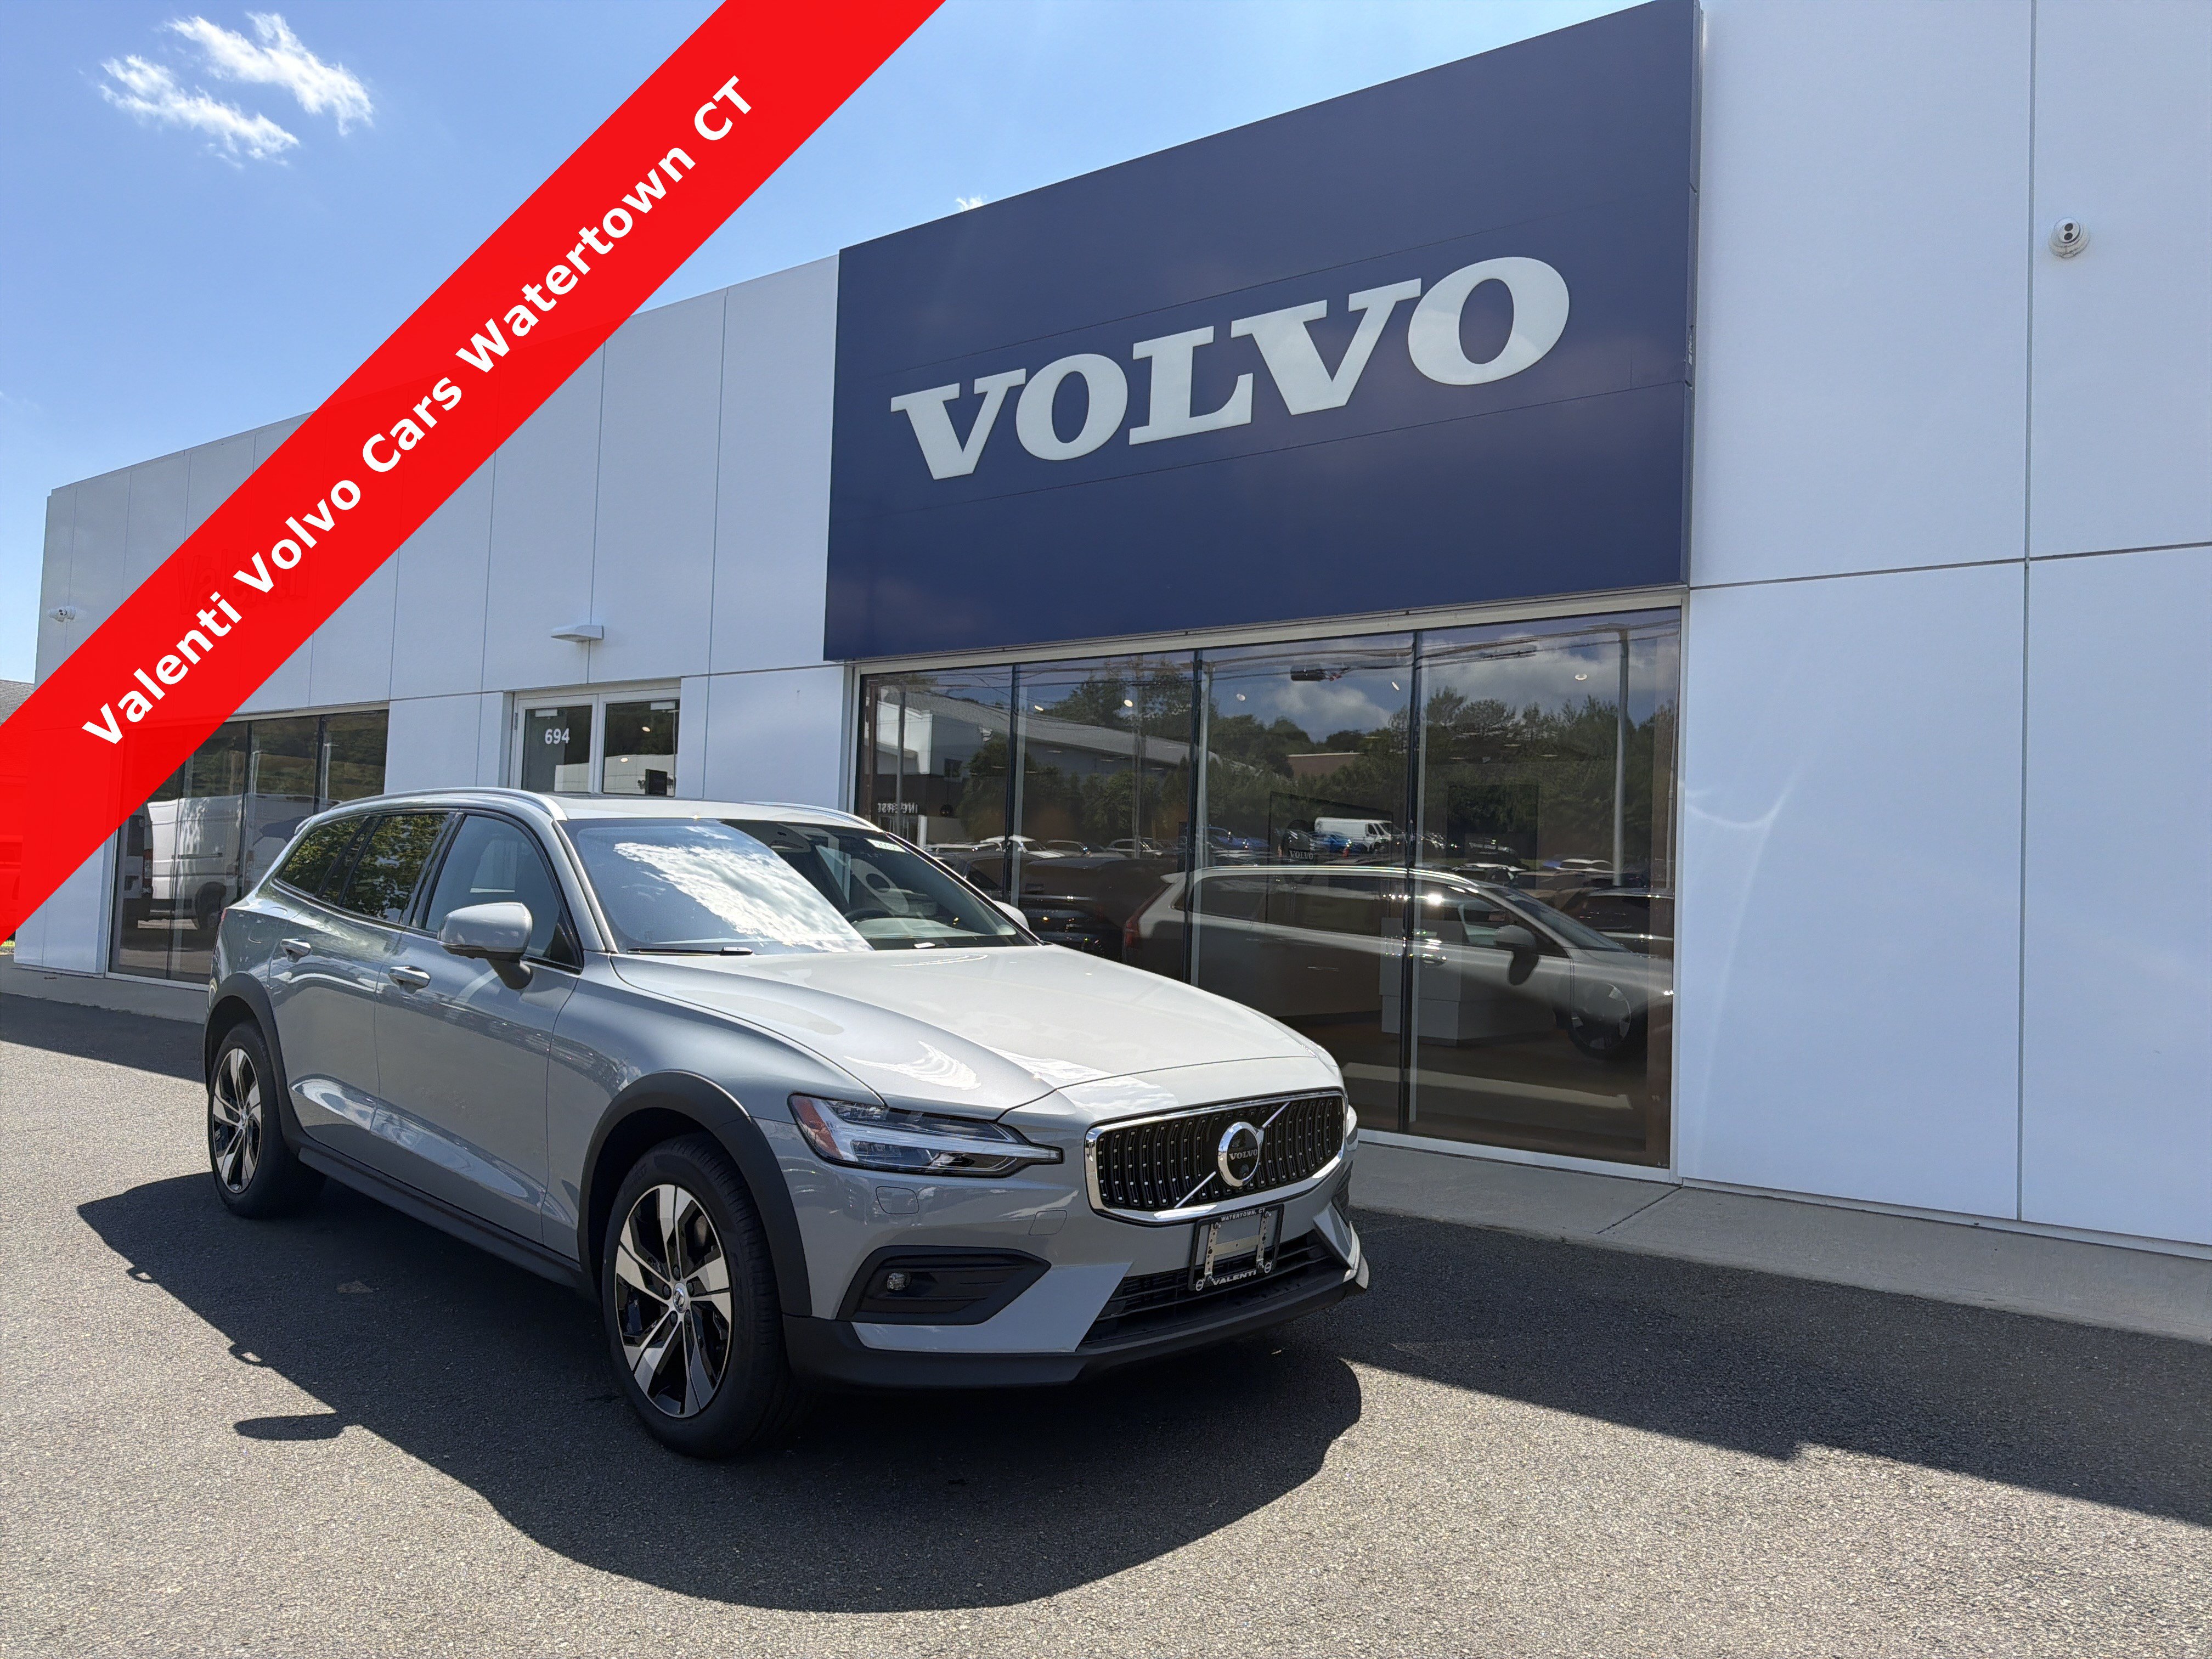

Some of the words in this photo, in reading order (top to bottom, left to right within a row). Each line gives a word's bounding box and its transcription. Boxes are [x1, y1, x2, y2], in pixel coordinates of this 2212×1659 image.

[891, 257, 1569, 479] VOLVO
[545, 728, 570, 744] 694
[1289, 850, 1313, 860] VOLVO
[1229, 1149, 1257, 1160] VOLVO
[1221, 1210, 1257, 1221] WATERTOWN,
[1213, 1270, 1257, 1285] VALENTI
